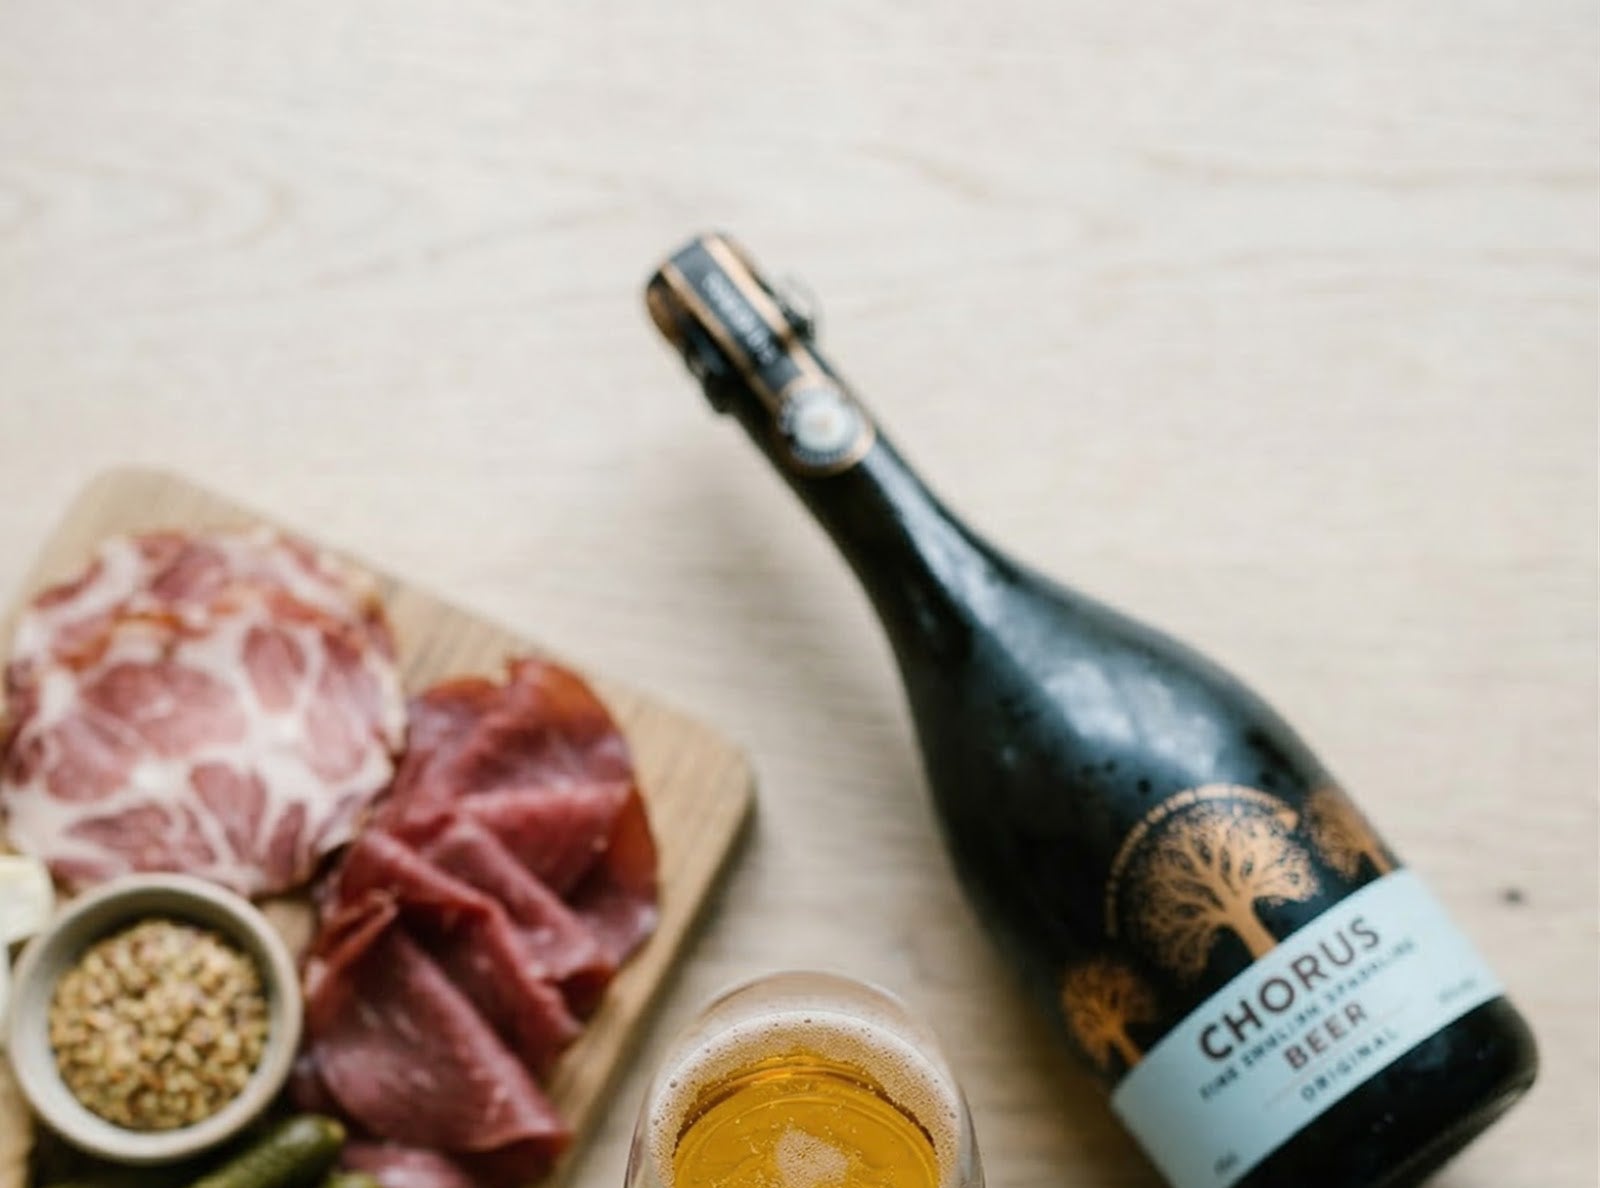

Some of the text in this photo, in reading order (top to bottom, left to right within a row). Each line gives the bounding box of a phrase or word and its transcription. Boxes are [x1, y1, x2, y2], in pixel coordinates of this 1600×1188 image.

[1199, 916, 1380, 1061] CHORUS
[1283, 1002, 1368, 1070] BEER
[1301, 1026, 1398, 1101] ORIGINAL
